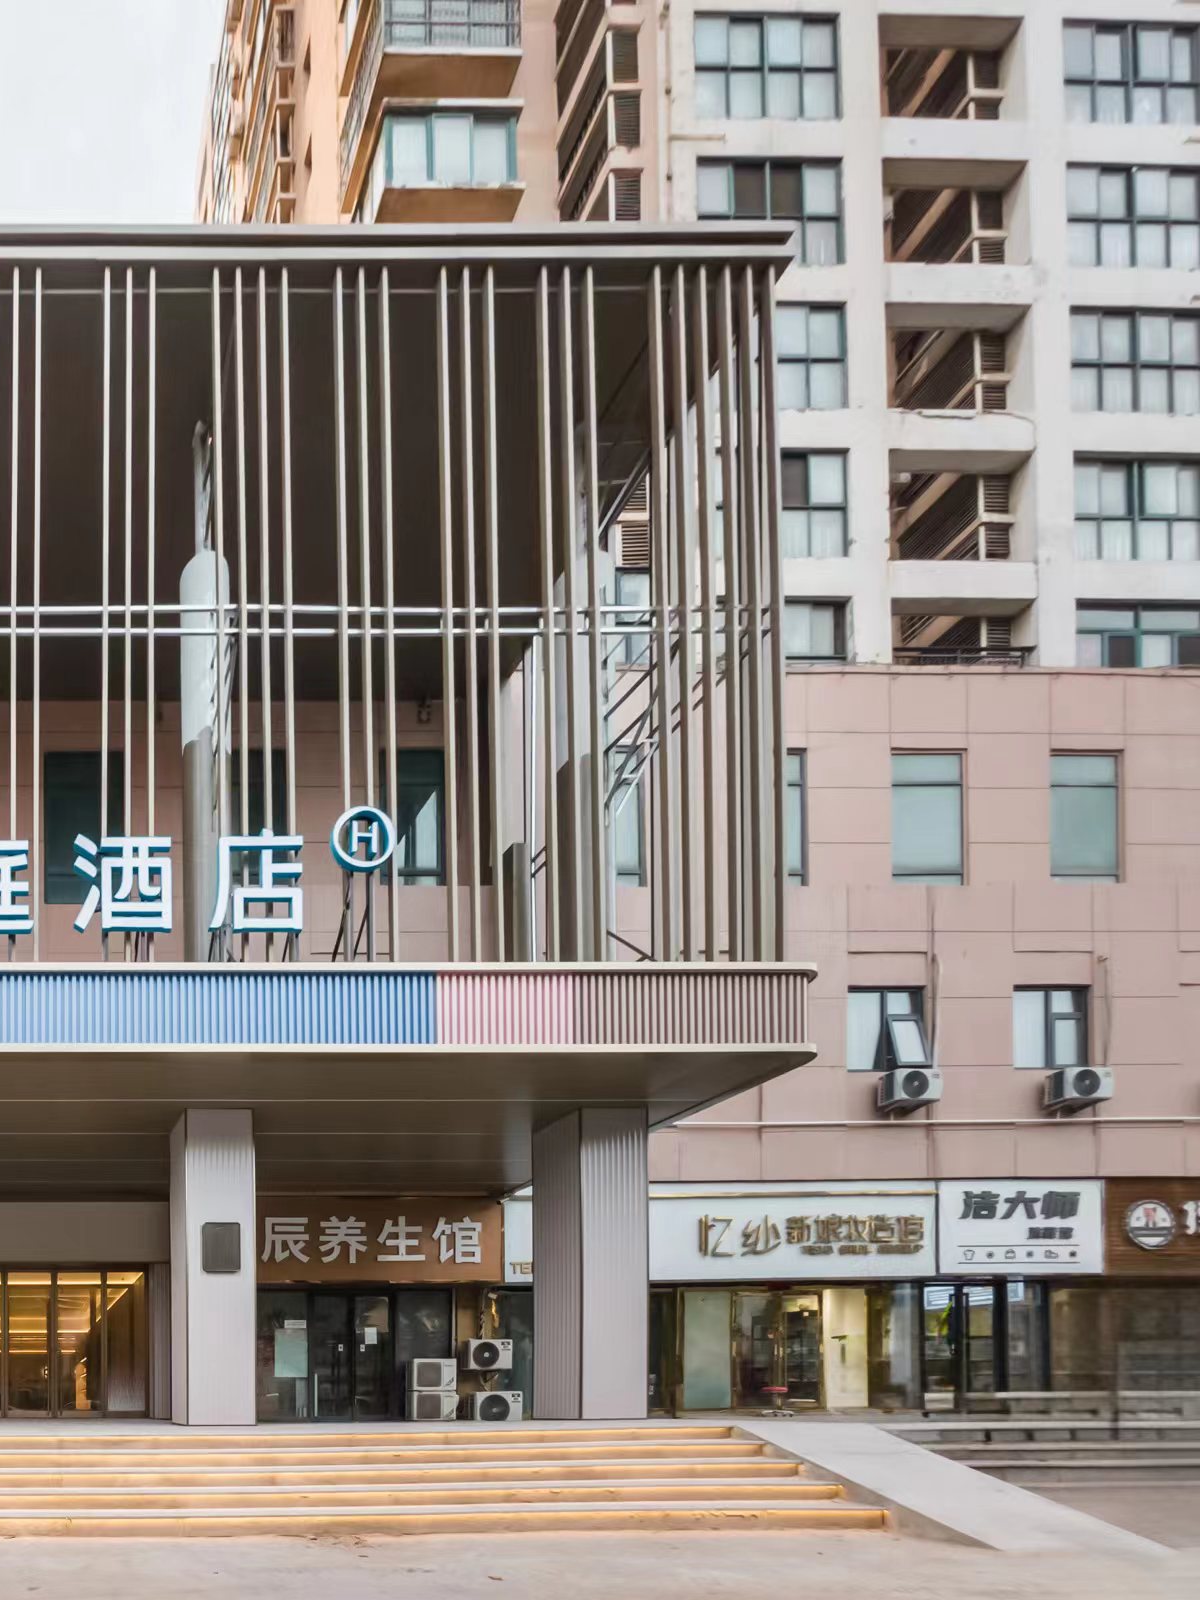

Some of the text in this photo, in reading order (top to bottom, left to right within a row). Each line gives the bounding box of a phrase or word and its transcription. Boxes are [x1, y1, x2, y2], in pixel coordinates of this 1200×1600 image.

[958, 1190, 1081, 1220] 洁大师
[261, 1215, 483, 1264] 辰养生馆
